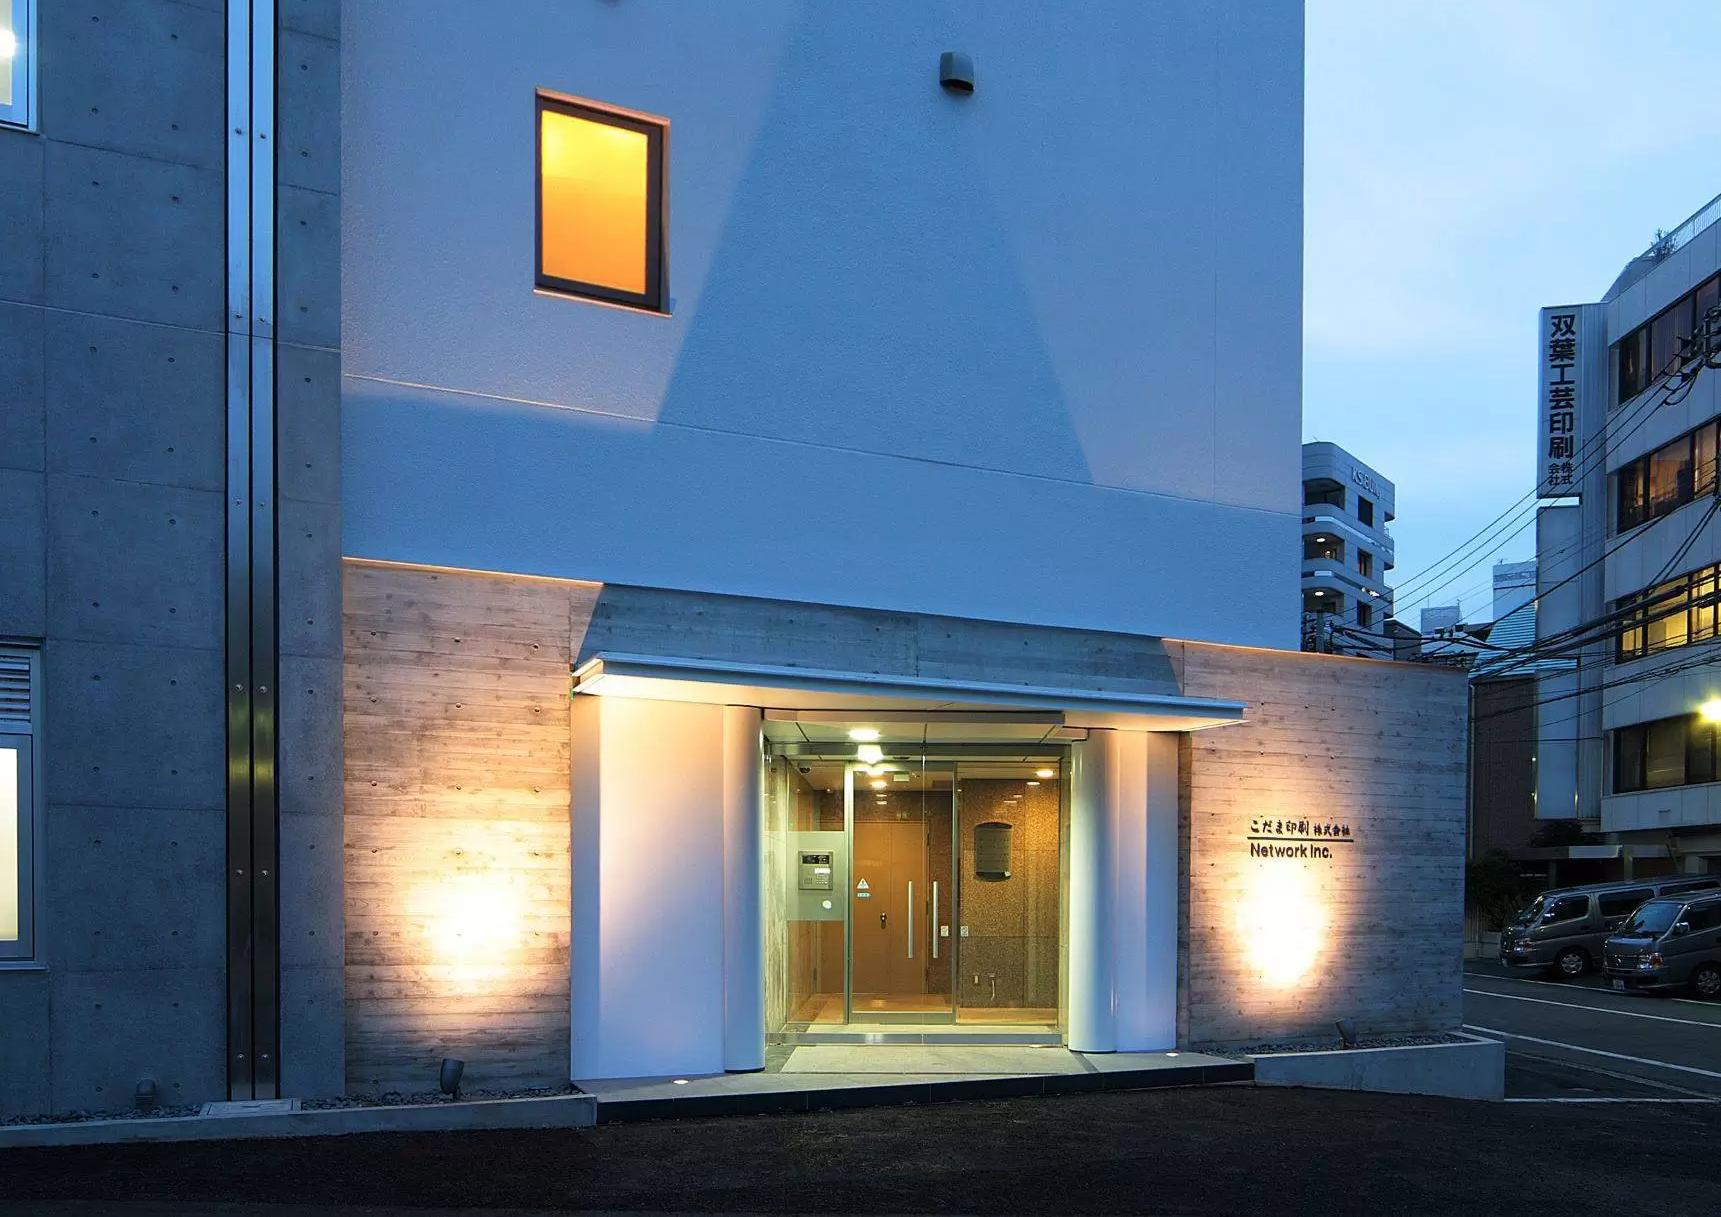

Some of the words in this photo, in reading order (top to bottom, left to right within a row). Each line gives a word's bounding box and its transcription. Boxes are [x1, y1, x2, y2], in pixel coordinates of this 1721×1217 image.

[1548, 314, 1576, 459] 双葉工芸印刷
[1250, 819, 1309, 836] こだま印刷
[1250, 843, 1308, 858] Network
[1310, 844, 1333, 859] Inc.
